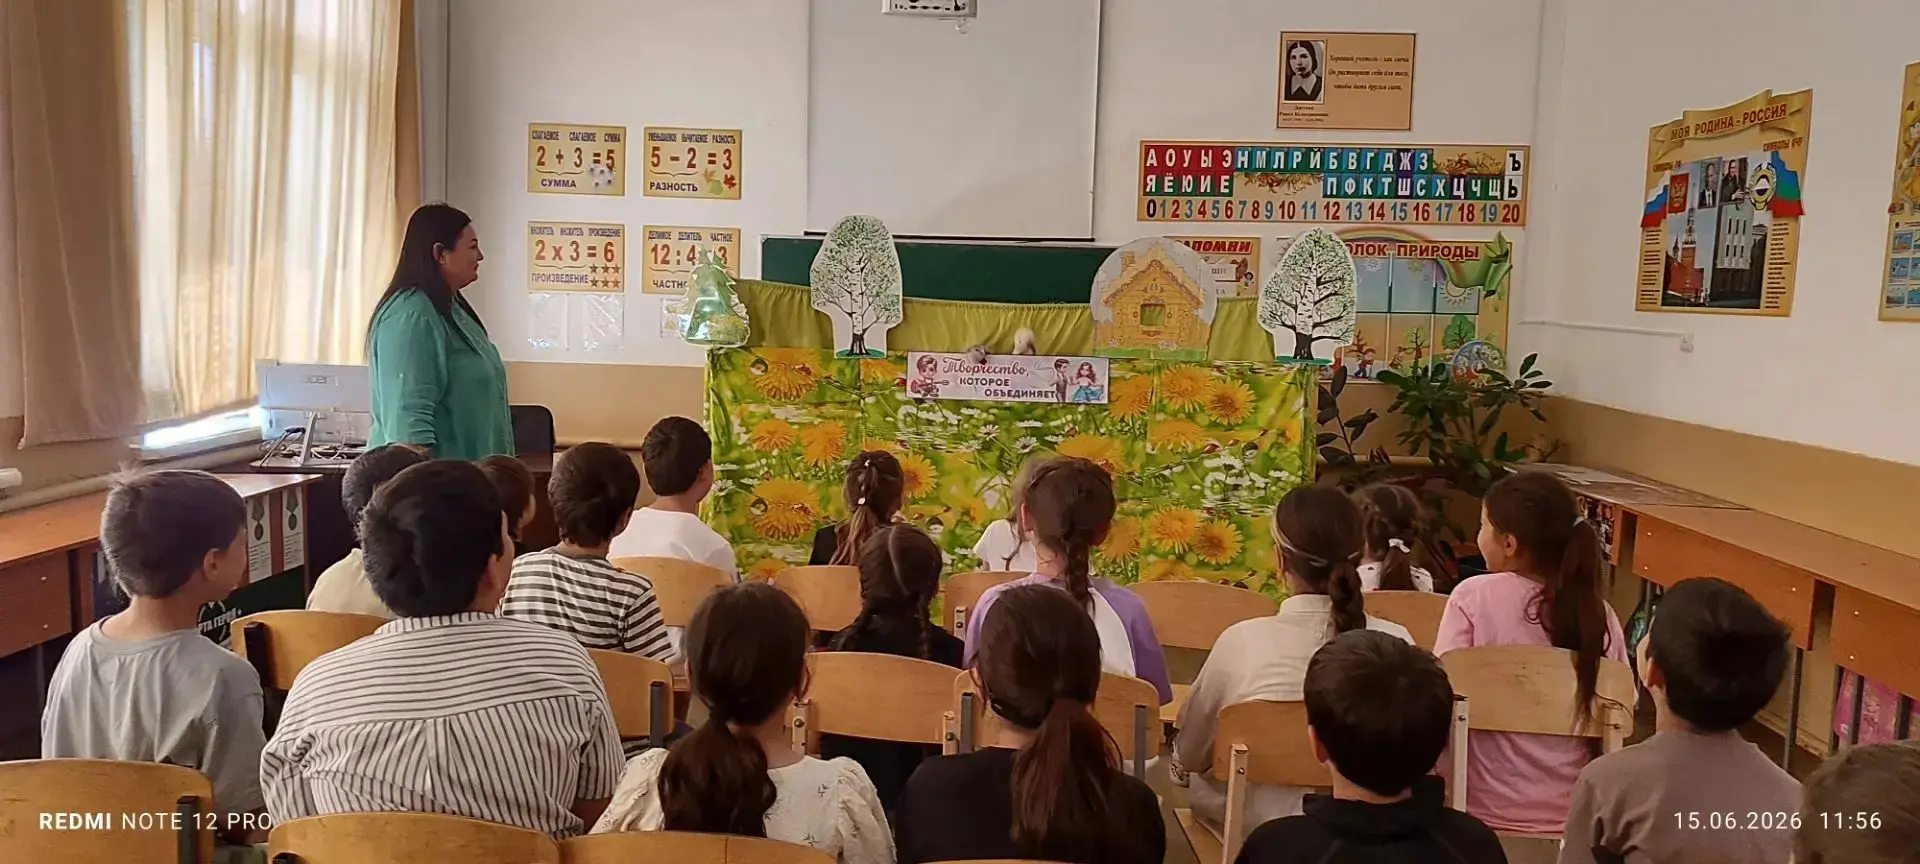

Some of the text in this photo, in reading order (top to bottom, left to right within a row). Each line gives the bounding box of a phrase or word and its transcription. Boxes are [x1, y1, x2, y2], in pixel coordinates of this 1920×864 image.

[1670, 127, 1690, 141] МОЯ
[1694, 116, 1734, 135] РОДИНА
[1743, 104, 1787, 125] РОССИЯ
[712, 134, 736, 144] РАЗНОСТЬ
[536, 145, 546, 166] 2
[574, 147, 583, 168] 3
[606, 149, 615, 171] 5
[651, 146, 661, 168] 5
[687, 147, 697, 169] 2
[723, 148, 732, 170] 3
[541, 178, 577, 188] СУММА
[650, 182, 698, 192] РАЗНОСТЬ
[1146, 199, 1520, 223] 0 1 2 3 4 5 6 7 8 9 10 11 12 13 14 15 16 17 18 19 20
[710, 233, 733, 242] ЧАСТНОЕ
[535, 239, 546, 261] 2
[569, 240, 580, 262] 3
[603, 241, 614, 263] 6
[1178, 240, 1252, 252] АПОМНИ
[1396, 244, 1479, 260] ПРИРОДЫ
[651, 243, 671, 265] 12
[686, 244, 696, 265] 4
[531, 273, 589, 283] ПРОИЗВЕДЕНИЕ
[653, 280, 688, 288] ЧАСТНО
[943, 357, 1029, 377] Творчество,
[959, 377, 1010, 387] КОТОРОЕ
[984, 389, 1056, 399] ОБЪЕДИНЯЕТ
